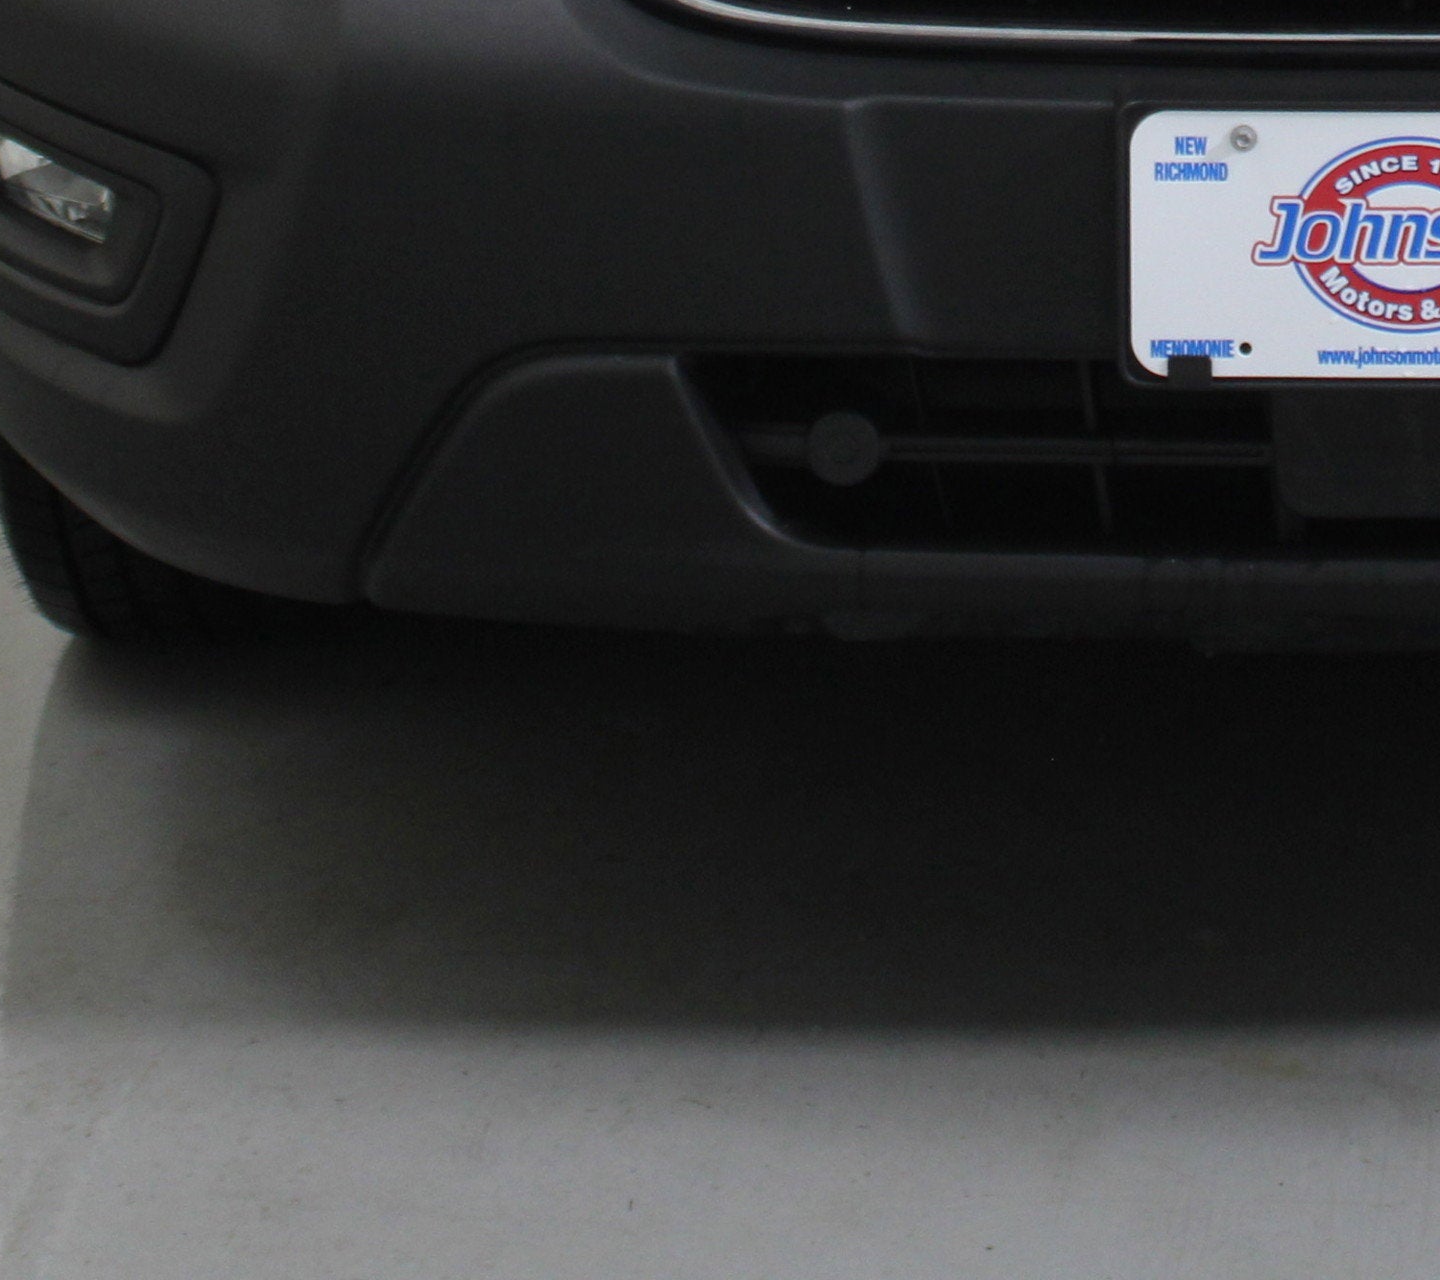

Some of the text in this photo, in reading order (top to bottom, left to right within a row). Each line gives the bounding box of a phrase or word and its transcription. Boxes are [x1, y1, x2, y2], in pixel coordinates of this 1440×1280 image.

[1174, 136, 1208, 156] NEW
[1154, 162, 1229, 182] RICHMOND
[1334, 155, 1419, 196] SINCE
[1318, 265, 1414, 322] Motors
[1150, 339, 1235, 358] MENOMONIE
